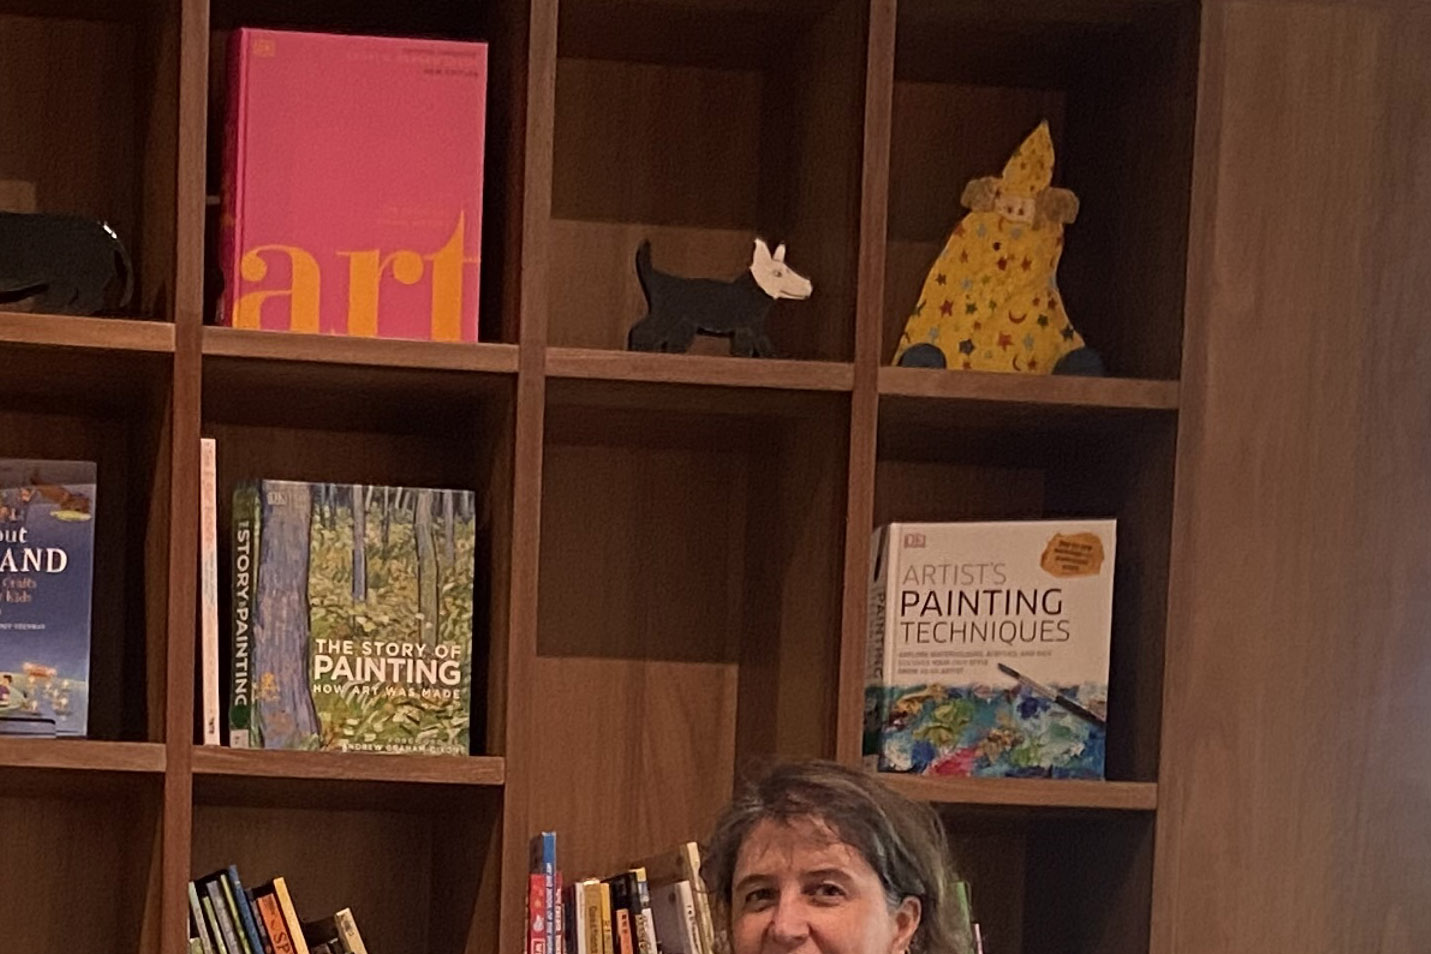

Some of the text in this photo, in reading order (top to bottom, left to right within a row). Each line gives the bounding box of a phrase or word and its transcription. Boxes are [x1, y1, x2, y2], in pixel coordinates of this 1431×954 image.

[231, 209, 480, 342] art
[234, 529, 251, 598] STORY
[902, 562, 1006, 585] ARTIST'S
[6, 589, 32, 603] Kids
[900, 588, 1062, 617] PAINTING
[900, 619, 1070, 646] TECHNIQUES
[315, 639, 462, 658] THE STORY OF
[314, 655, 461, 685] PAINTING
[312, 683, 461, 699] HOW ART WAS MADE
[589, 905, 598, 954] Questions
